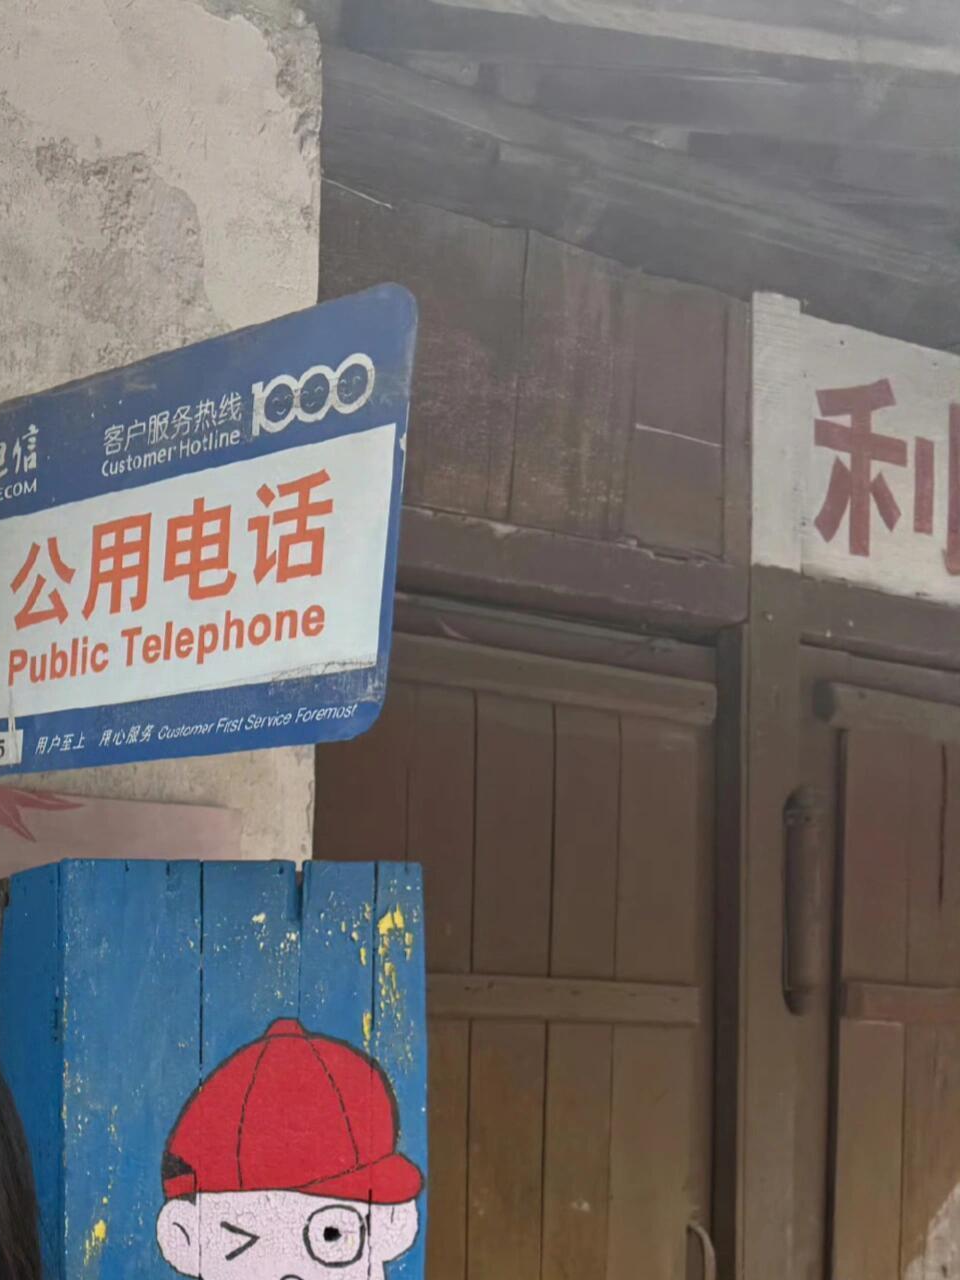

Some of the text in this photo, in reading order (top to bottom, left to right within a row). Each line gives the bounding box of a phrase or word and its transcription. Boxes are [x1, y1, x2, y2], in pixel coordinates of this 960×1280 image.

[103, 353, 375, 456] 客户服务热线 1000
[101, 430, 241, 477] Customer Hotline
[9, 468, 334, 632] 公用电话
[7, 603, 326, 687] Public Telephone
[35, 731, 86, 755] 用户至上
[157, 703, 359, 741] Customer First Service Foremost
